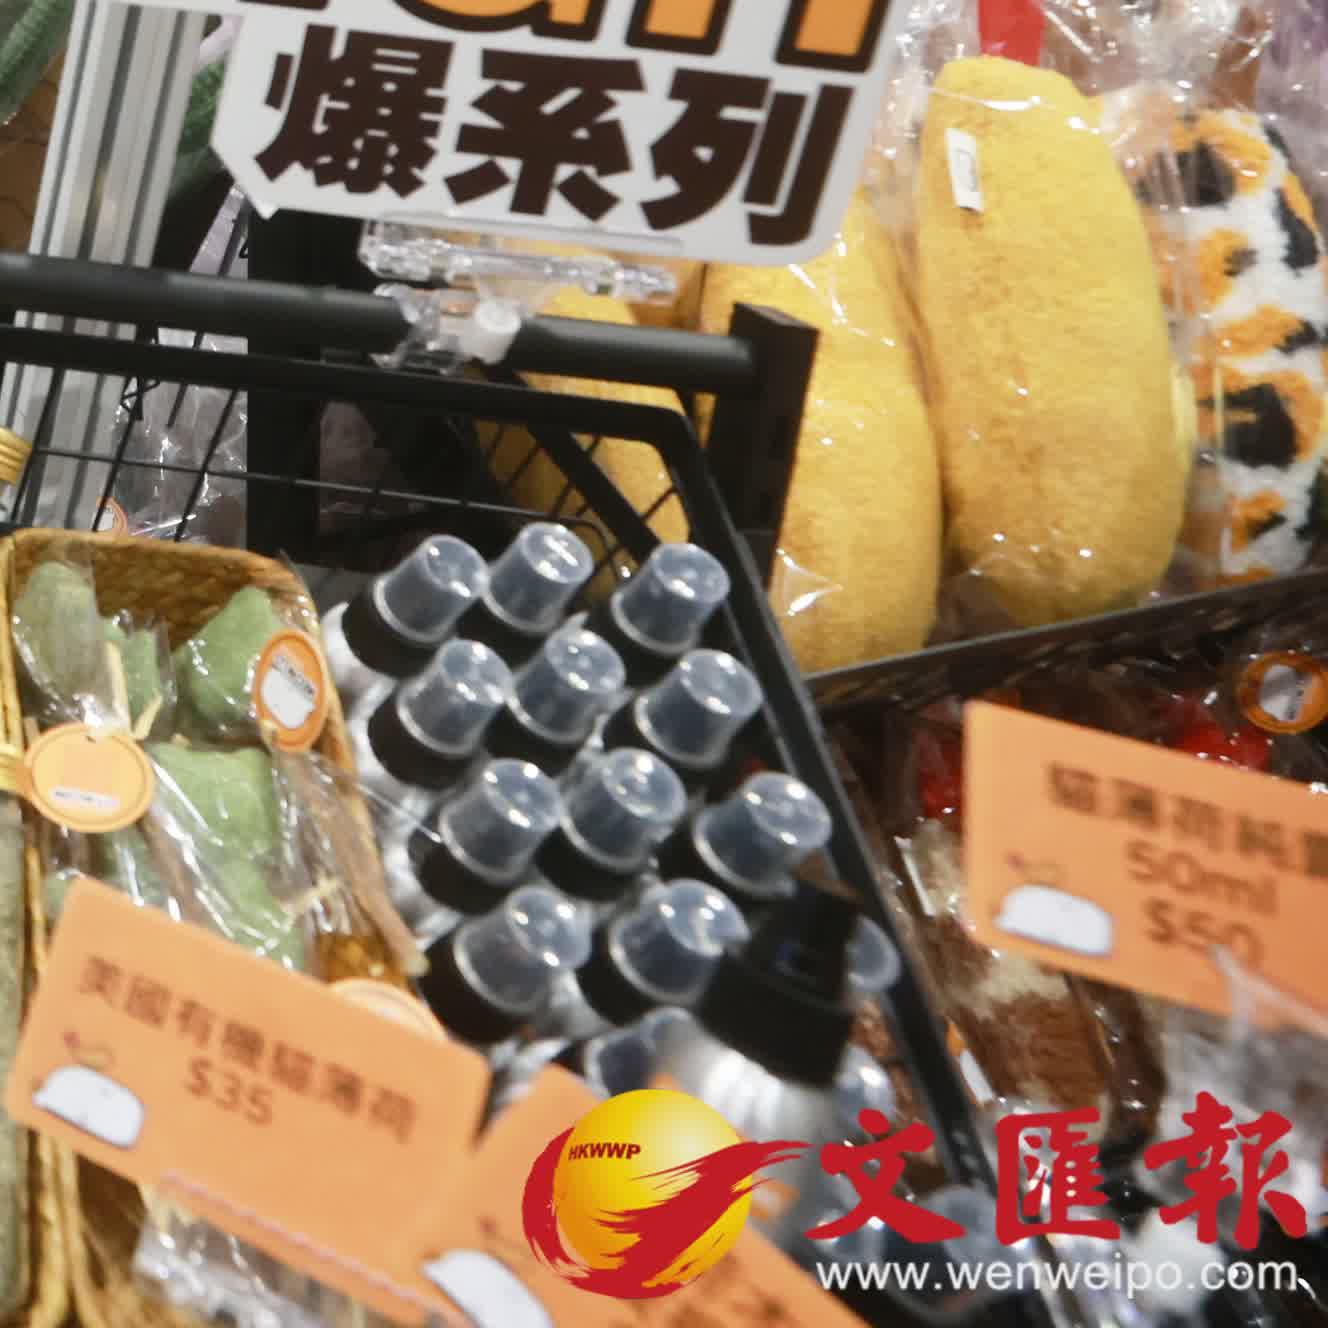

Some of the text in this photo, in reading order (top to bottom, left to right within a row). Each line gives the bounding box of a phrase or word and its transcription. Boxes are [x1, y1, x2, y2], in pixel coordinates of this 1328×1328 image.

[254, 26, 853, 247] 爆系列
[185, 1056, 274, 1126] $35
